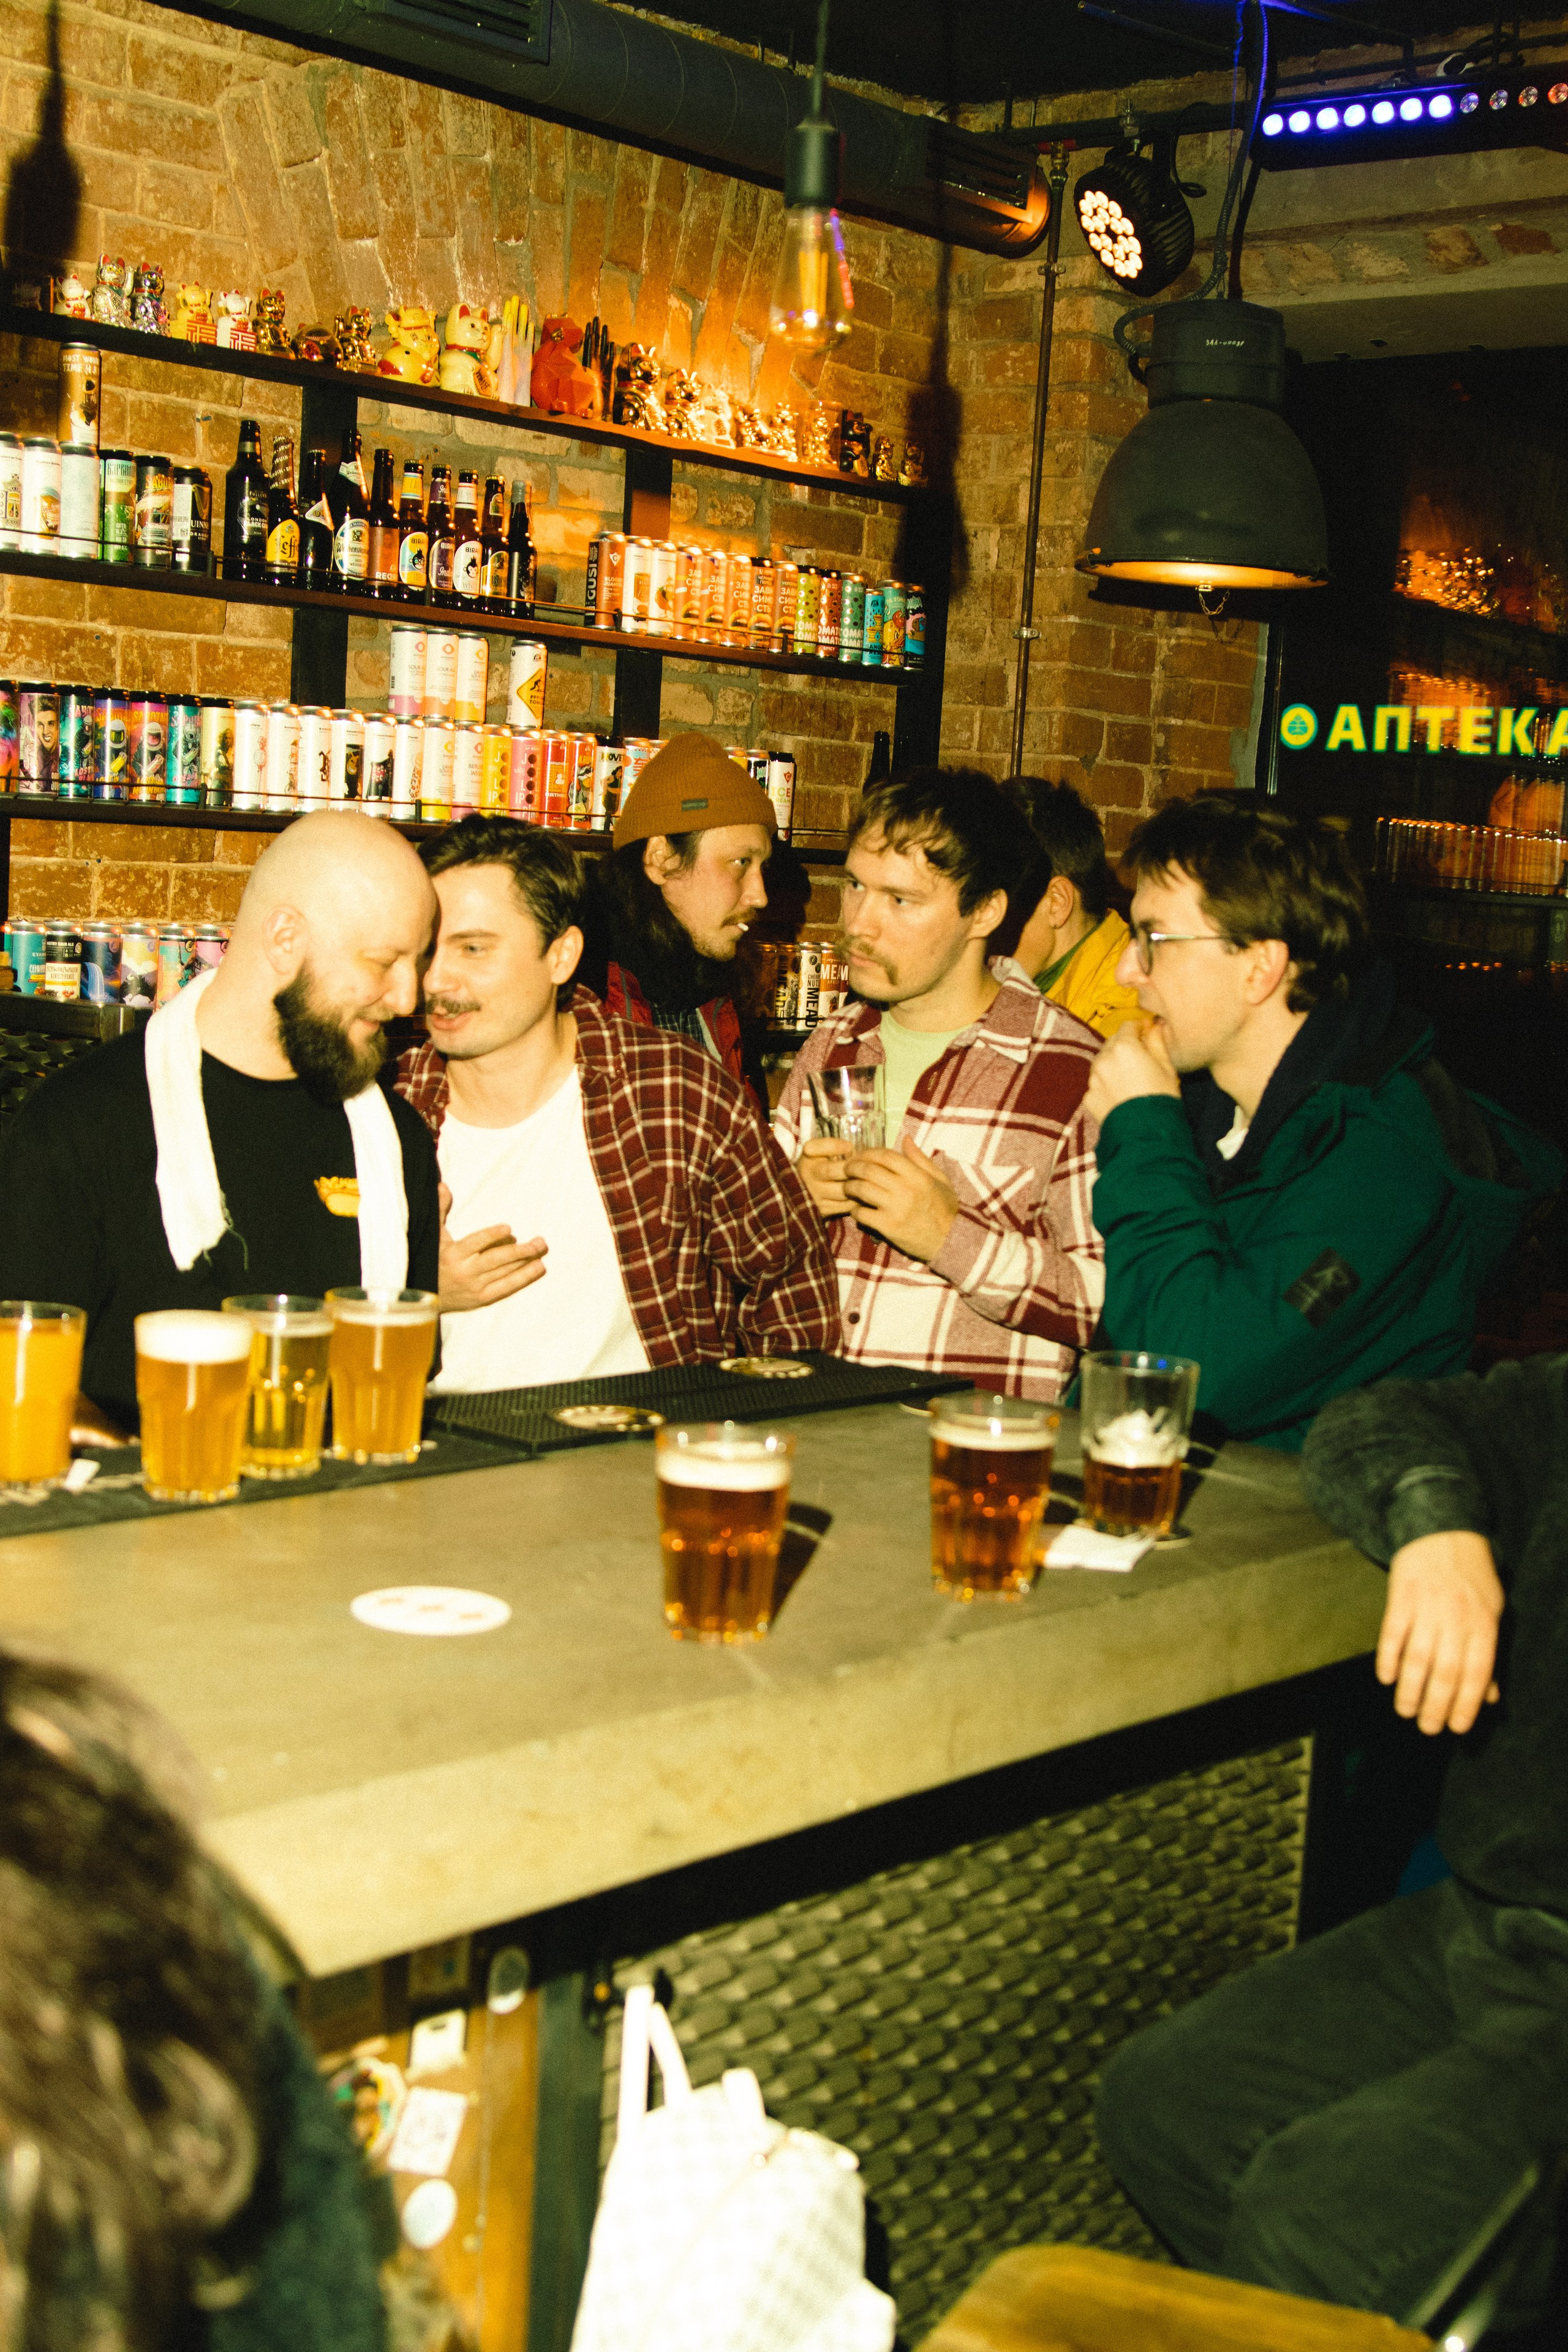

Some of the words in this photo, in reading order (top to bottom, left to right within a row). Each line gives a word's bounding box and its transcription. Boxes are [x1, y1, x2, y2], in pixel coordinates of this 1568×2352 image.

[587, 563, 598, 600] GUSI
[1325, 703, 1568, 758] АПТЕКА
[772, 786, 791, 797] ICE
[805, 987, 820, 1028] MEAD
